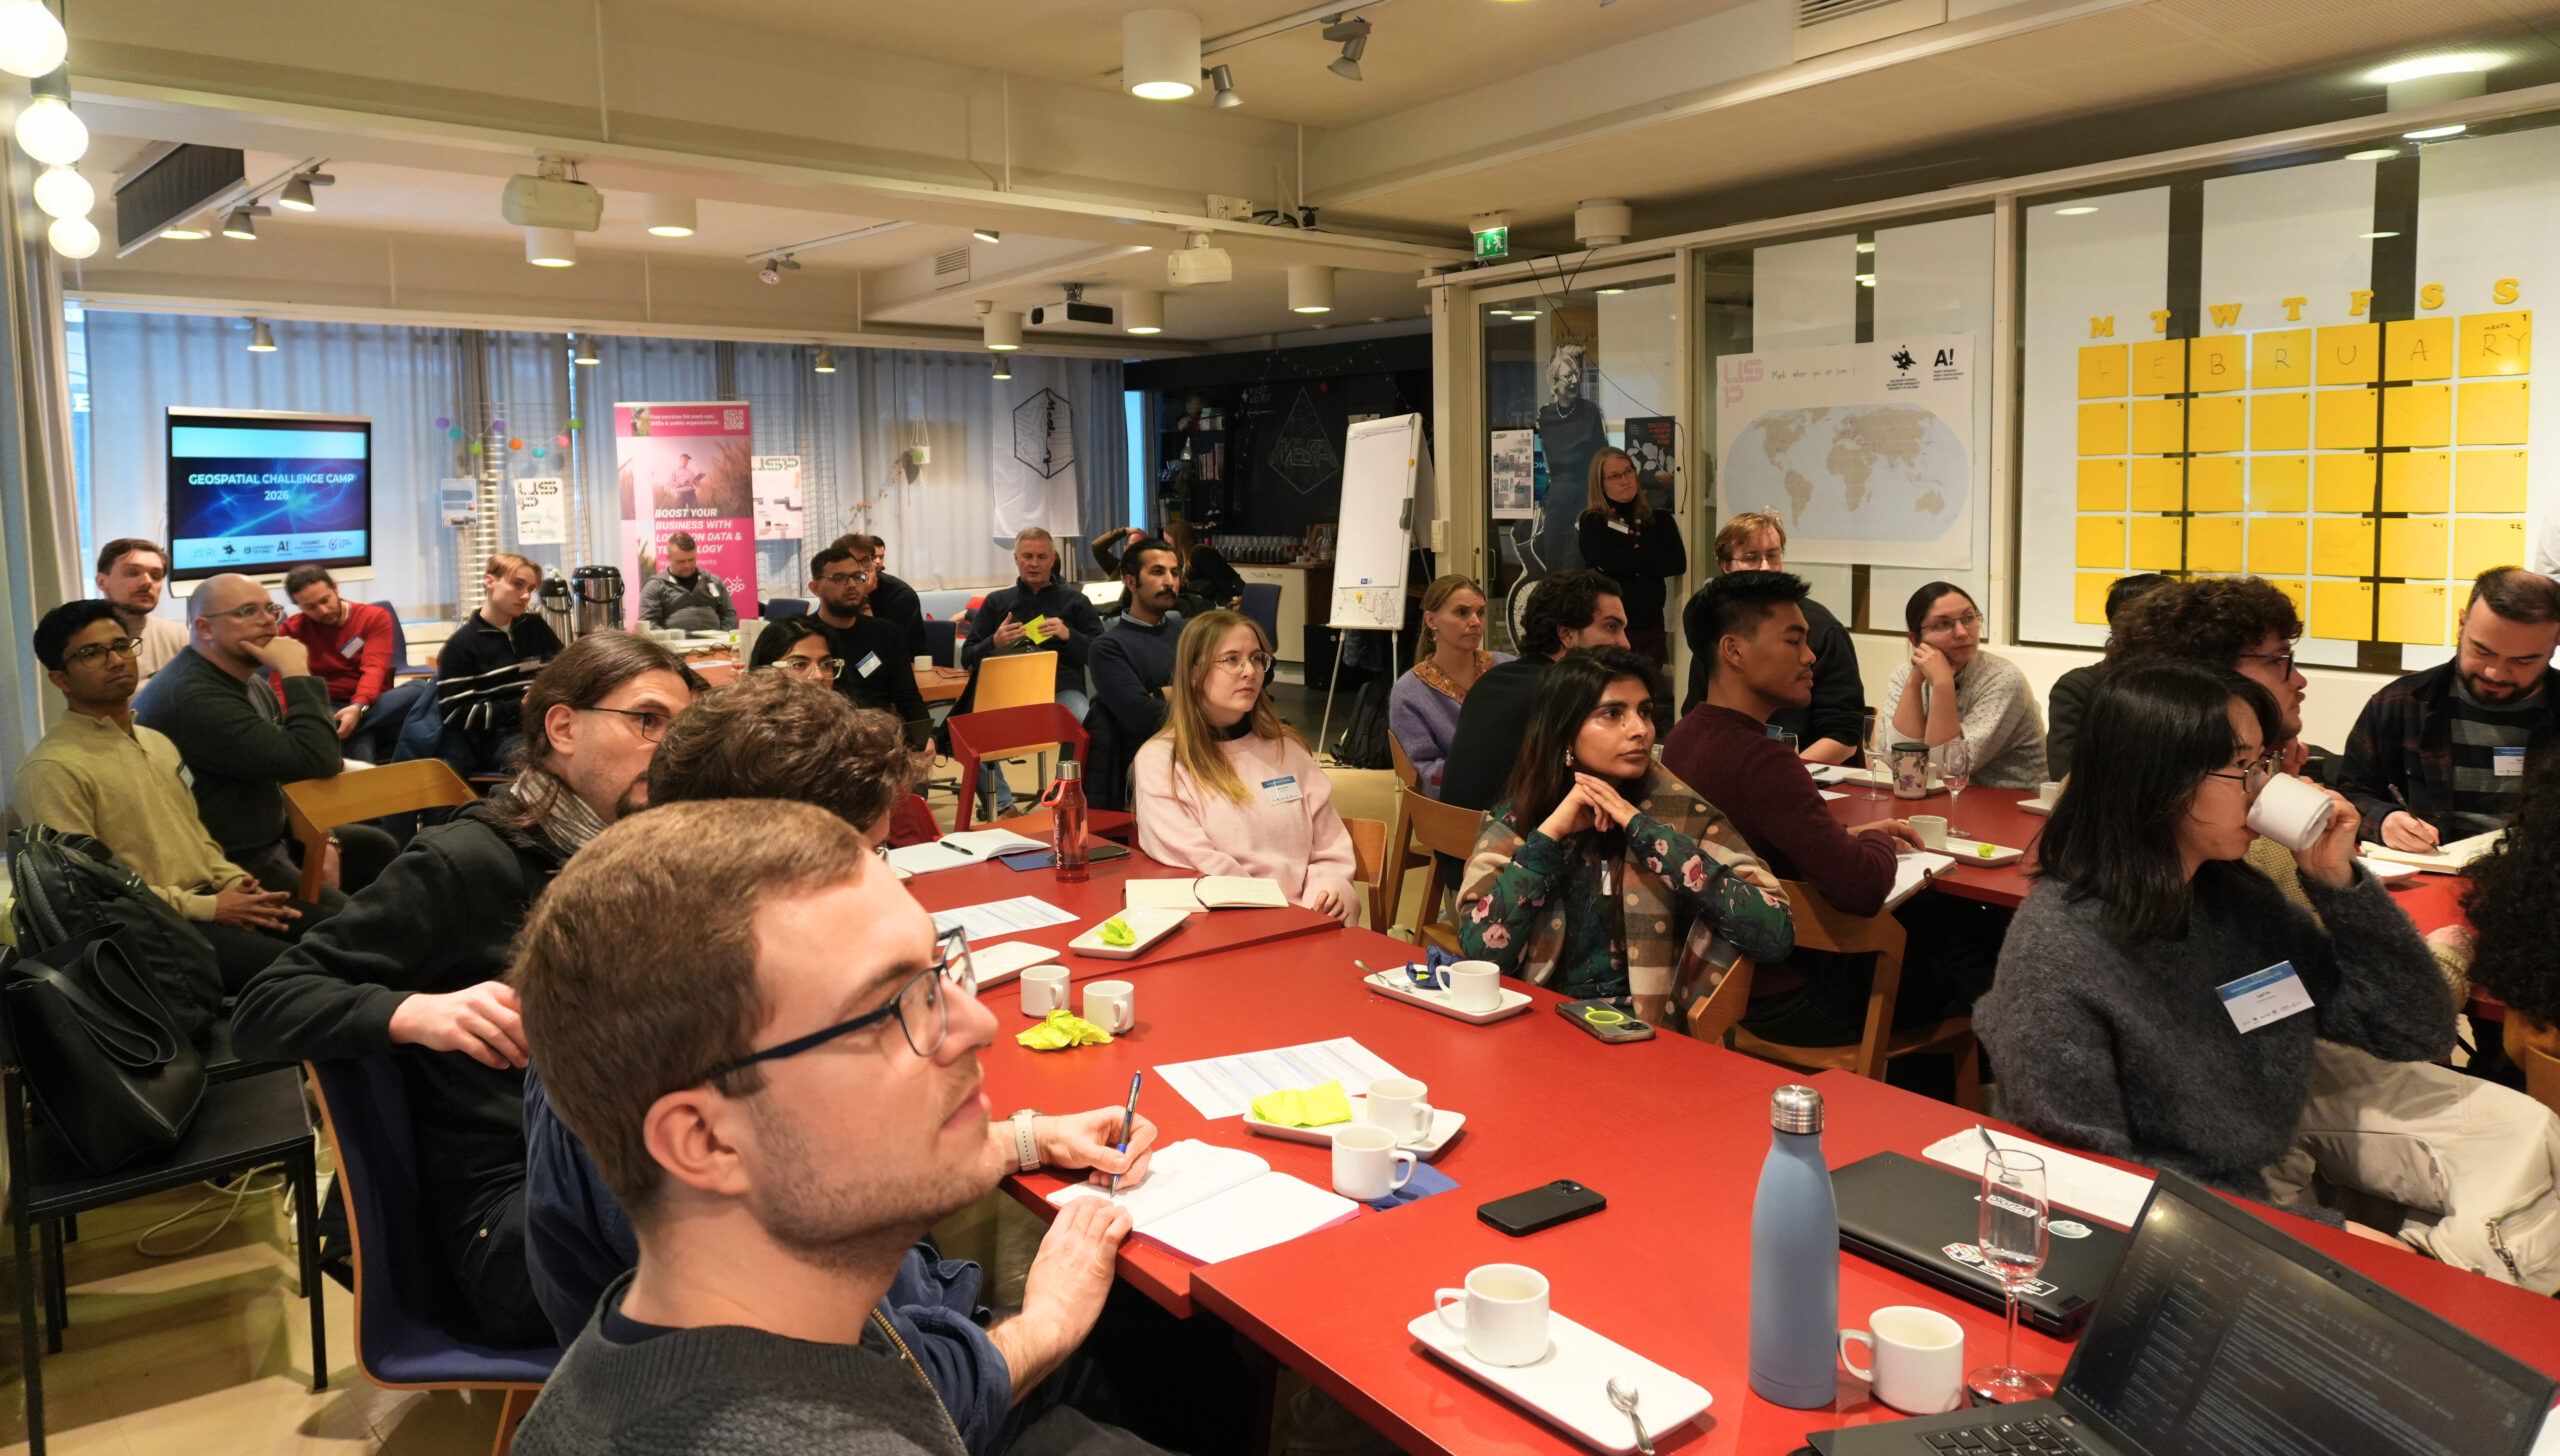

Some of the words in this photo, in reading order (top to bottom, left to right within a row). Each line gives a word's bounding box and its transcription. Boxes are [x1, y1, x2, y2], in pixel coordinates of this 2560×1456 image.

[2089, 315, 2115, 338] M
[2150, 309, 2171, 333] T
[2208, 303, 2243, 327] W
[2282, 297, 2307, 321] T
[2348, 290, 2374, 315] F
[2419, 284, 2445, 309] S
[2492, 278, 2519, 304] S
[2521, 313, 2528, 322] 1
[1934, 348, 1954, 367] A!
[2153, 355, 2165, 379] E
[2210, 353, 2226, 375] B
[2275, 348, 2290, 369] R
[2336, 344, 2358, 366] U
[2410, 338, 2428, 361] A
[1724, 359, 1765, 384] US
[188, 473, 260, 485] GEOSPATIAL
[262, 473, 324, 485] CHALLENGE
[325, 473, 355, 484] CAMP
[264, 490, 289, 501] 2026
[655, 508, 689, 519] BOOST
[690, 508, 718, 517] YOUR
[655, 521, 703, 530] BUSINESS
[706, 520, 732, 529] WITH
[707, 532, 733, 541] DATA
[734, 532, 742, 541] &
[277, 540, 289, 552] A!
[657, 544, 724, 554] TELOGY
